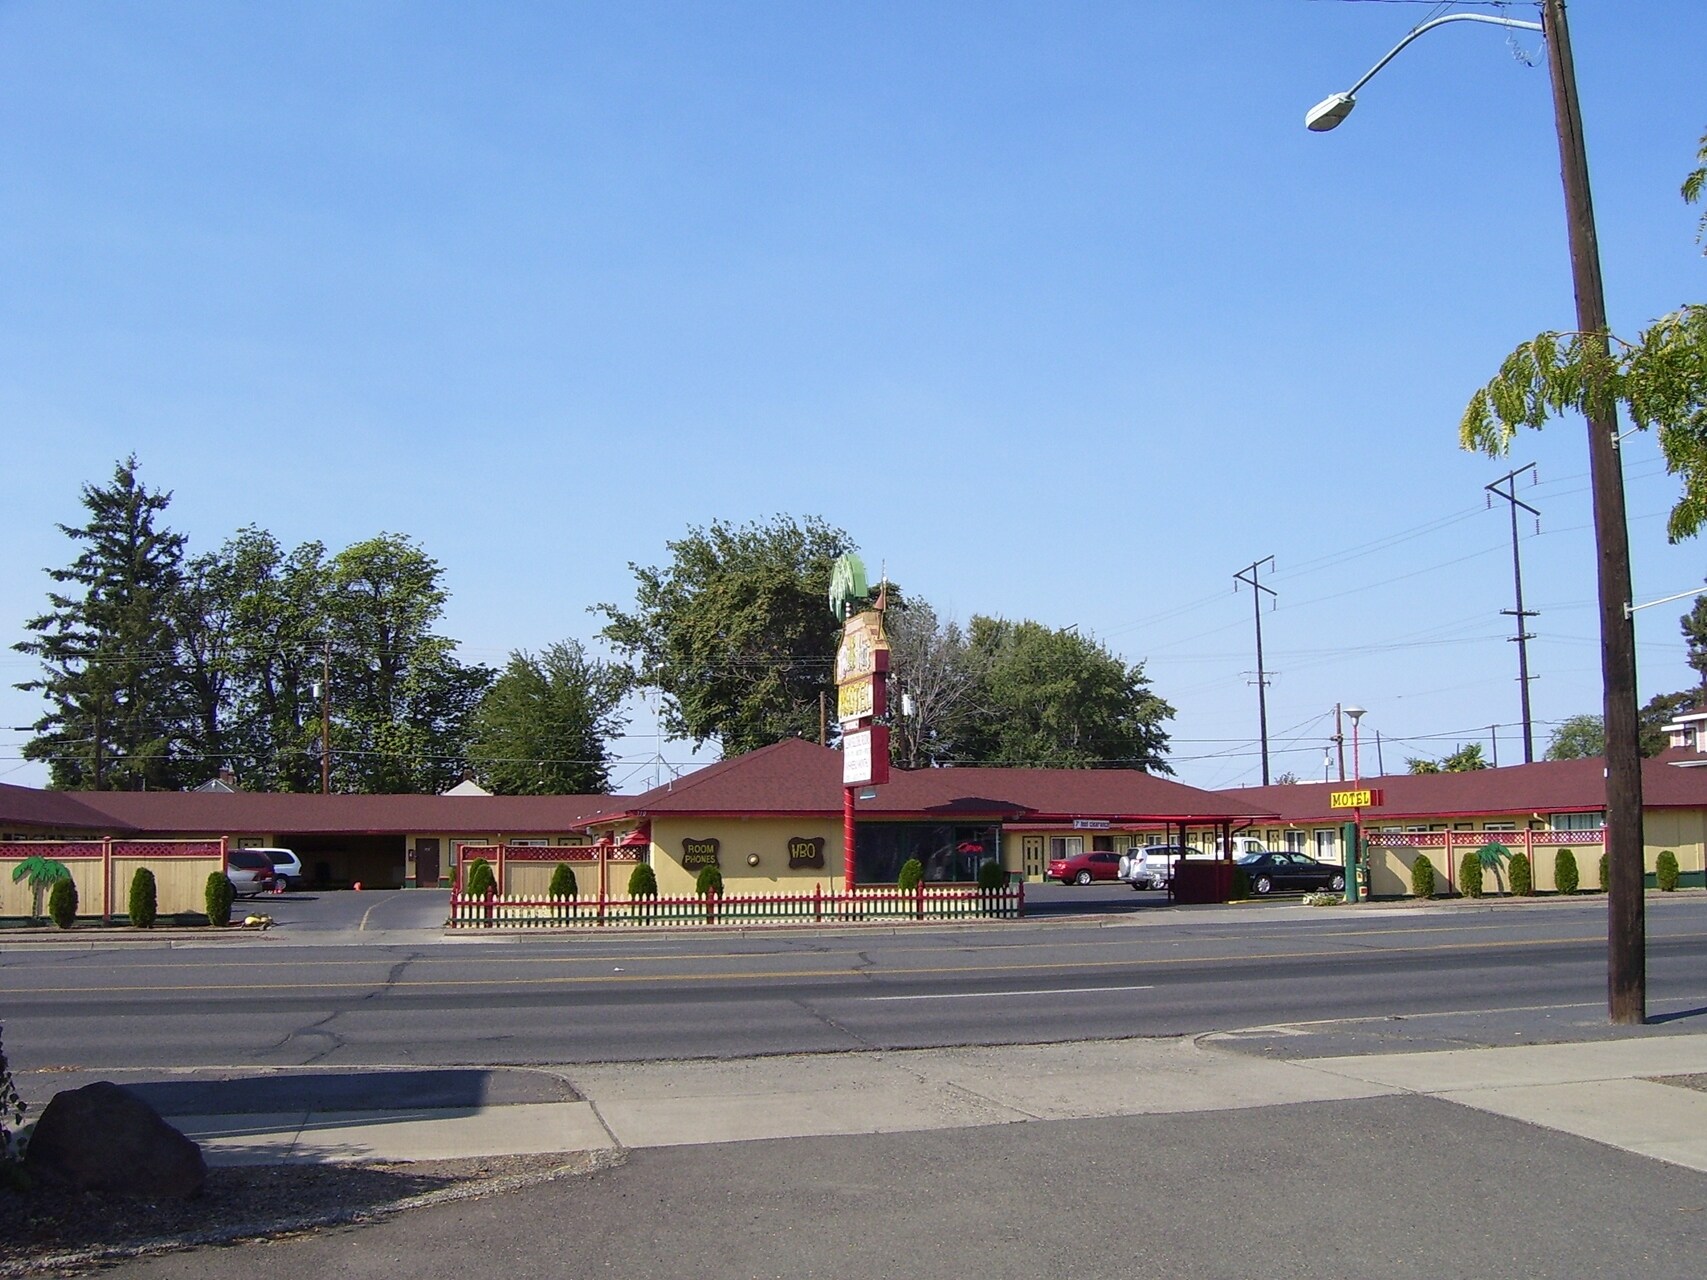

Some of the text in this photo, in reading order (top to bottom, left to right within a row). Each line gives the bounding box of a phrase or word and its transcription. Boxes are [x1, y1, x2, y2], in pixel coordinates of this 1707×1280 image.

[1332, 792, 1369, 806] MOTEL
[687, 844, 714, 854] ROOM
[791, 843, 816, 858] HBO
[685, 855, 716, 864] PHONES
